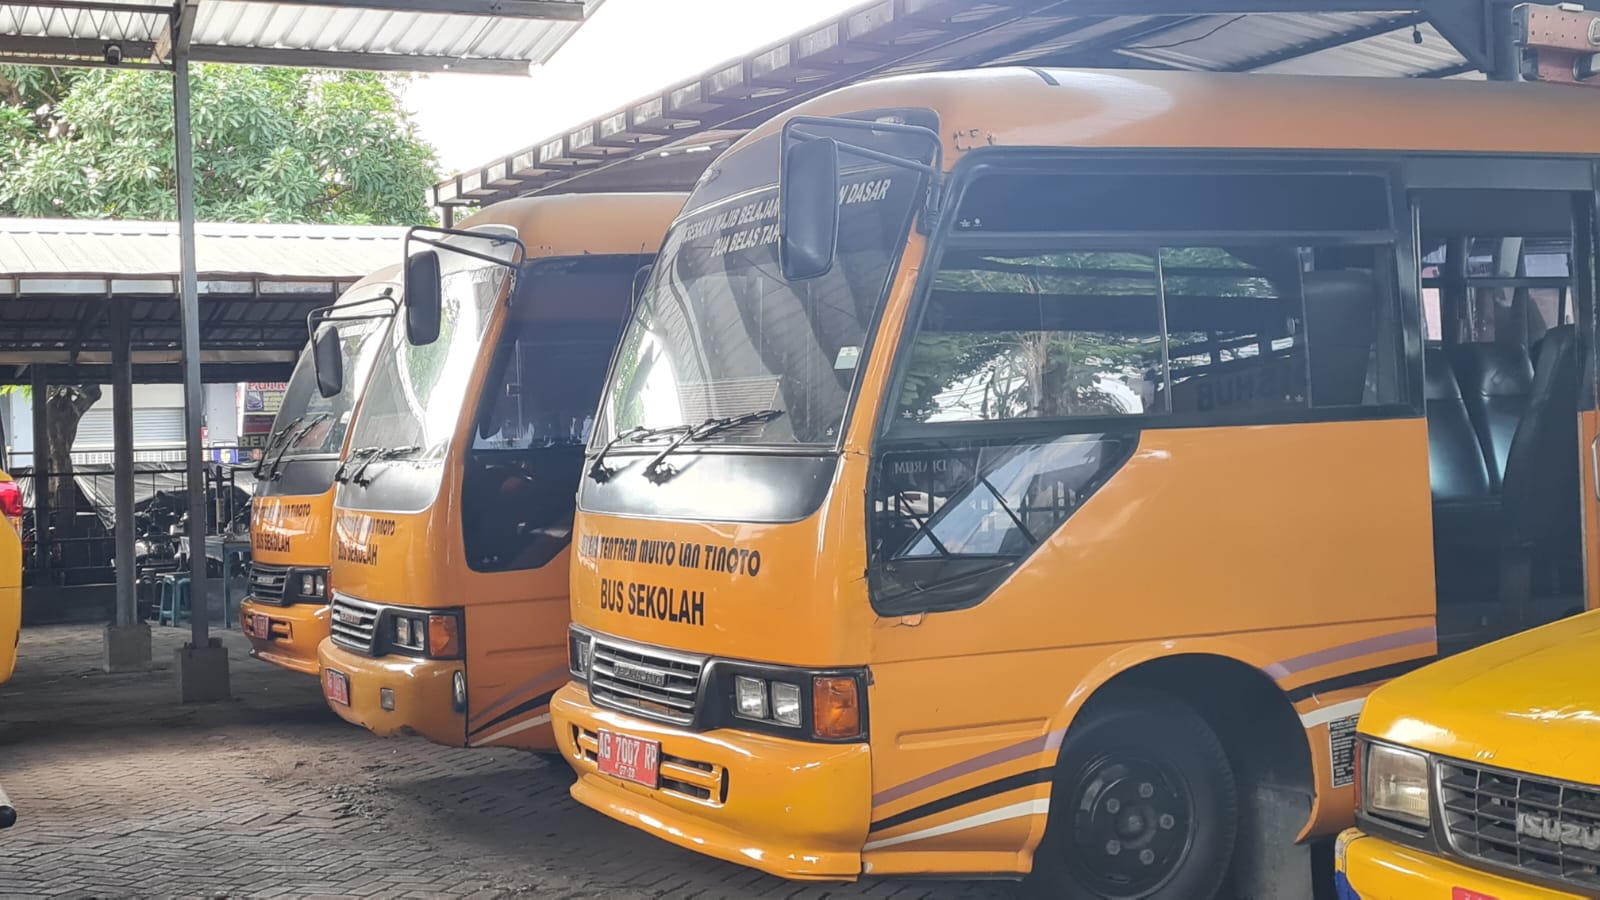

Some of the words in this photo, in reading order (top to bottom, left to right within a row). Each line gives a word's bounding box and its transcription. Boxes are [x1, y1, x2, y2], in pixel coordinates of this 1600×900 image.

[846, 179, 892, 204] DASAR
[728, 228, 761, 253] BELAS
[600, 578, 624, 613] BUS
[627, 582, 705, 626] SEKOLAH
[598, 732, 611, 760] AG
[1516, 813, 1600, 850] ISUZU
